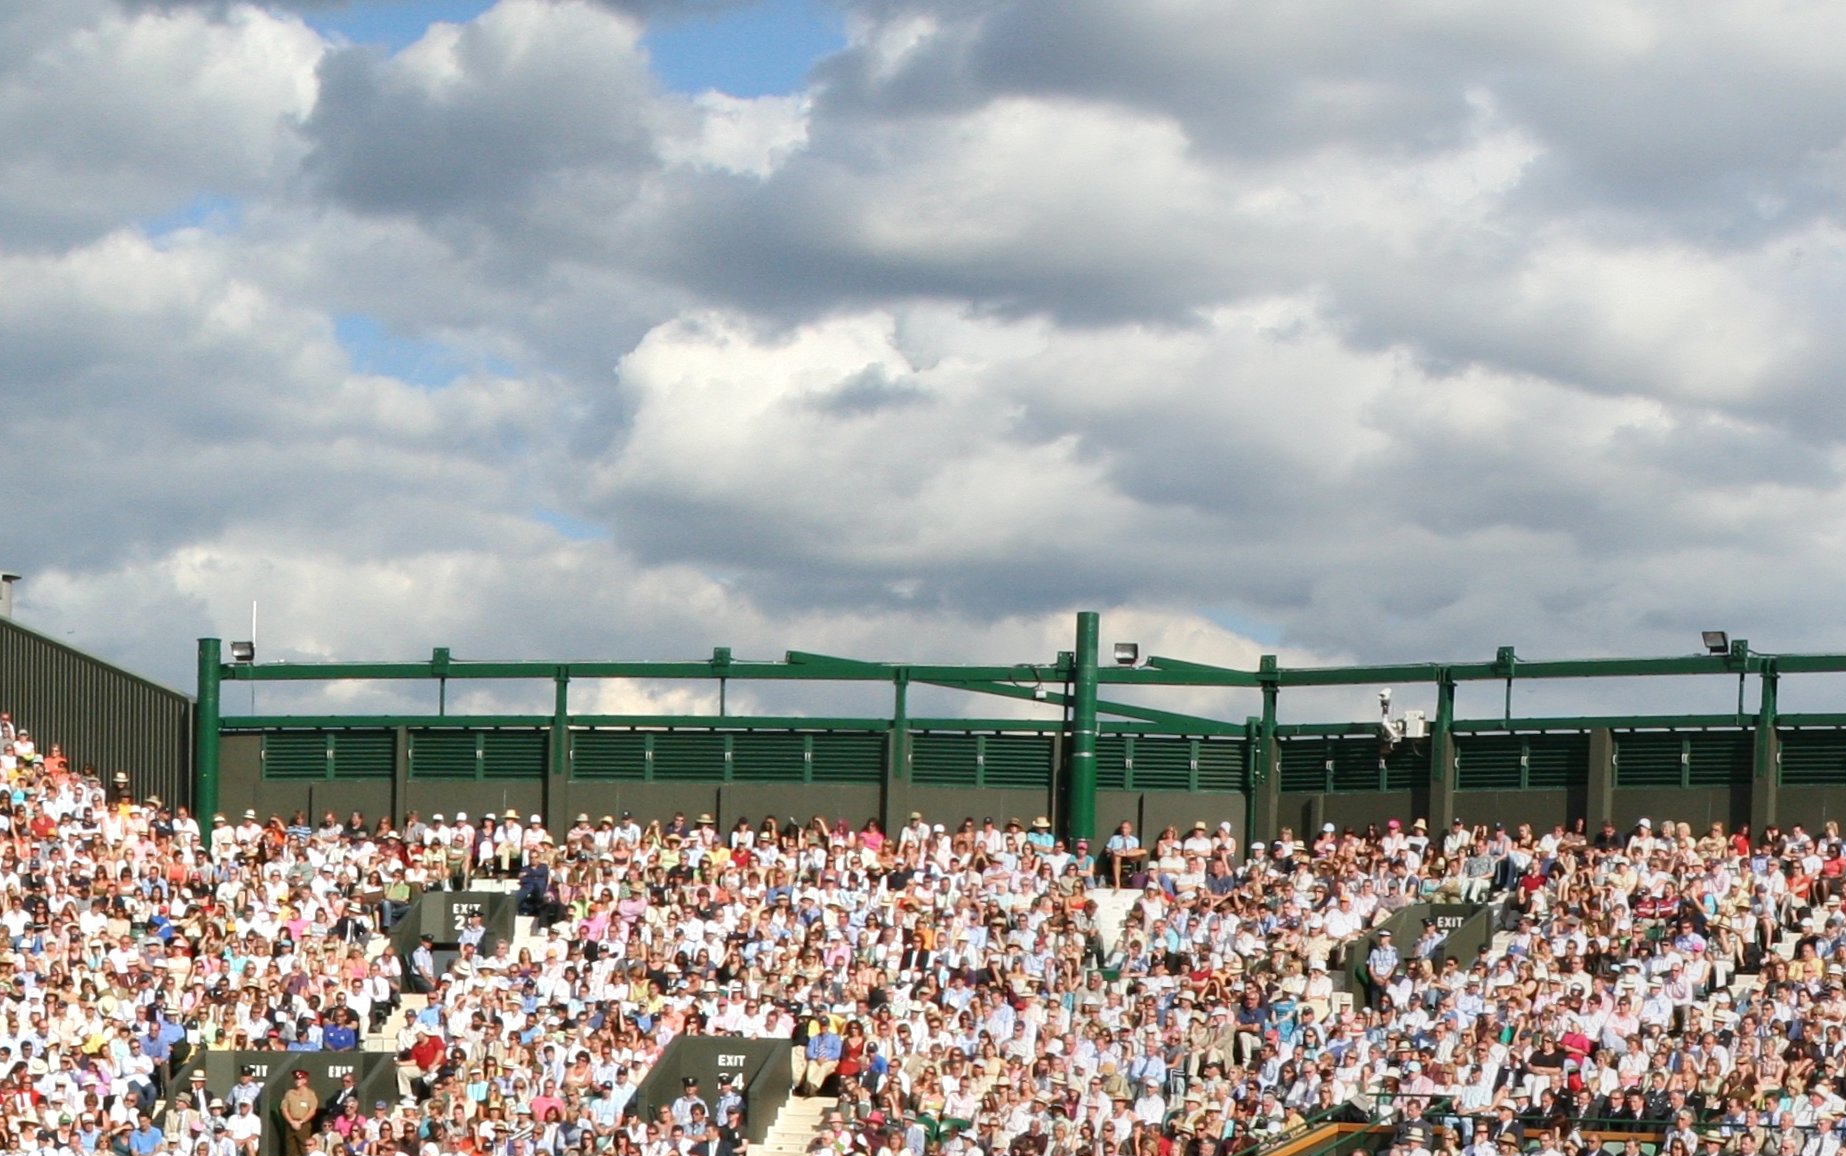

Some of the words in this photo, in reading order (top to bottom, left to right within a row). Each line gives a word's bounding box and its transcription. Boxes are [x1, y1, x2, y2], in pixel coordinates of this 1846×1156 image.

[452, 903, 481, 914] EXIT
[1437, 916, 1464, 928] EXIT
[717, 1054, 746, 1067] EXIT
